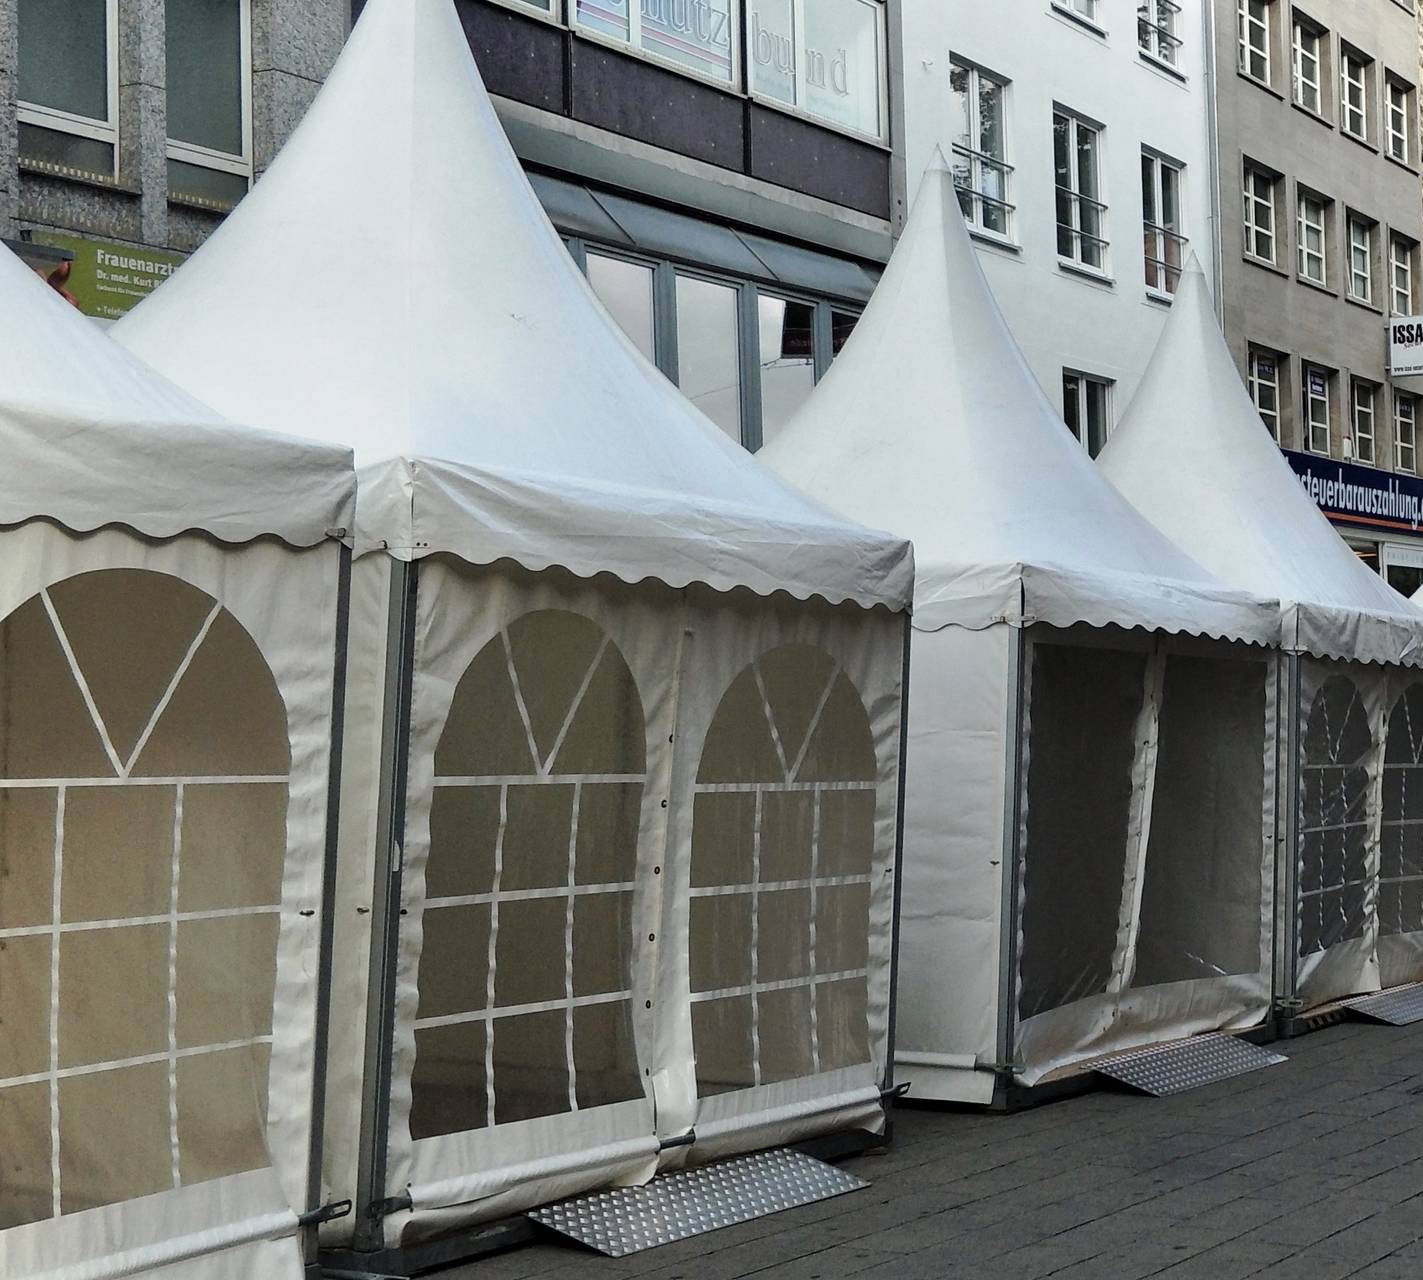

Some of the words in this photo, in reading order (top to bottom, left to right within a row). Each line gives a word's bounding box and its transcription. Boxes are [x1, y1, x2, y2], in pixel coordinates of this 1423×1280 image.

[96, 249, 178, 276] Frauenarzt
[96, 269, 109, 281] Dr.
[111, 273, 131, 284] med.
[133, 276, 153, 288] Kurt
